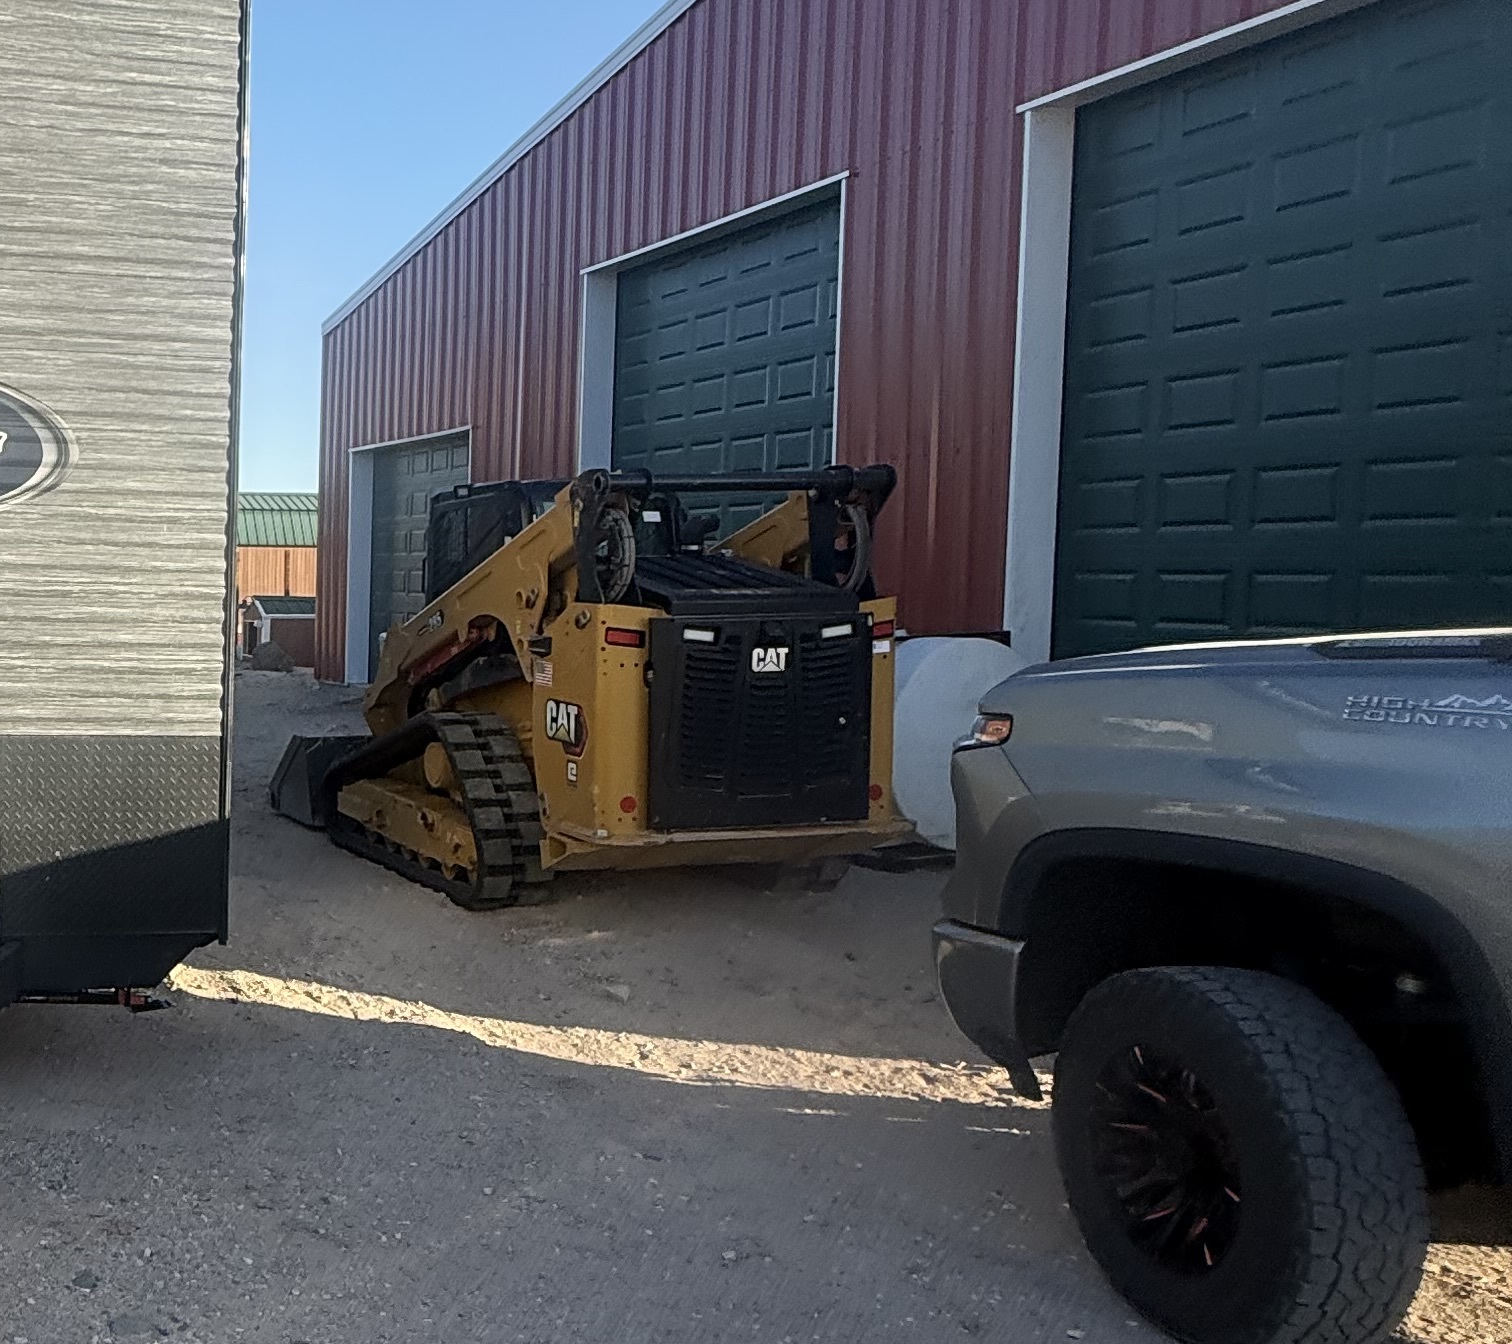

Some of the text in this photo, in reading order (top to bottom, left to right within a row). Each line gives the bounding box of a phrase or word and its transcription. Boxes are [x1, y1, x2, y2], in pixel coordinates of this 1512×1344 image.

[751, 647, 789, 672] CAT
[1346, 694, 1431, 710] HIGH
[546, 699, 579, 744] CAT
[1342, 707, 1509, 730] COUNTRY
